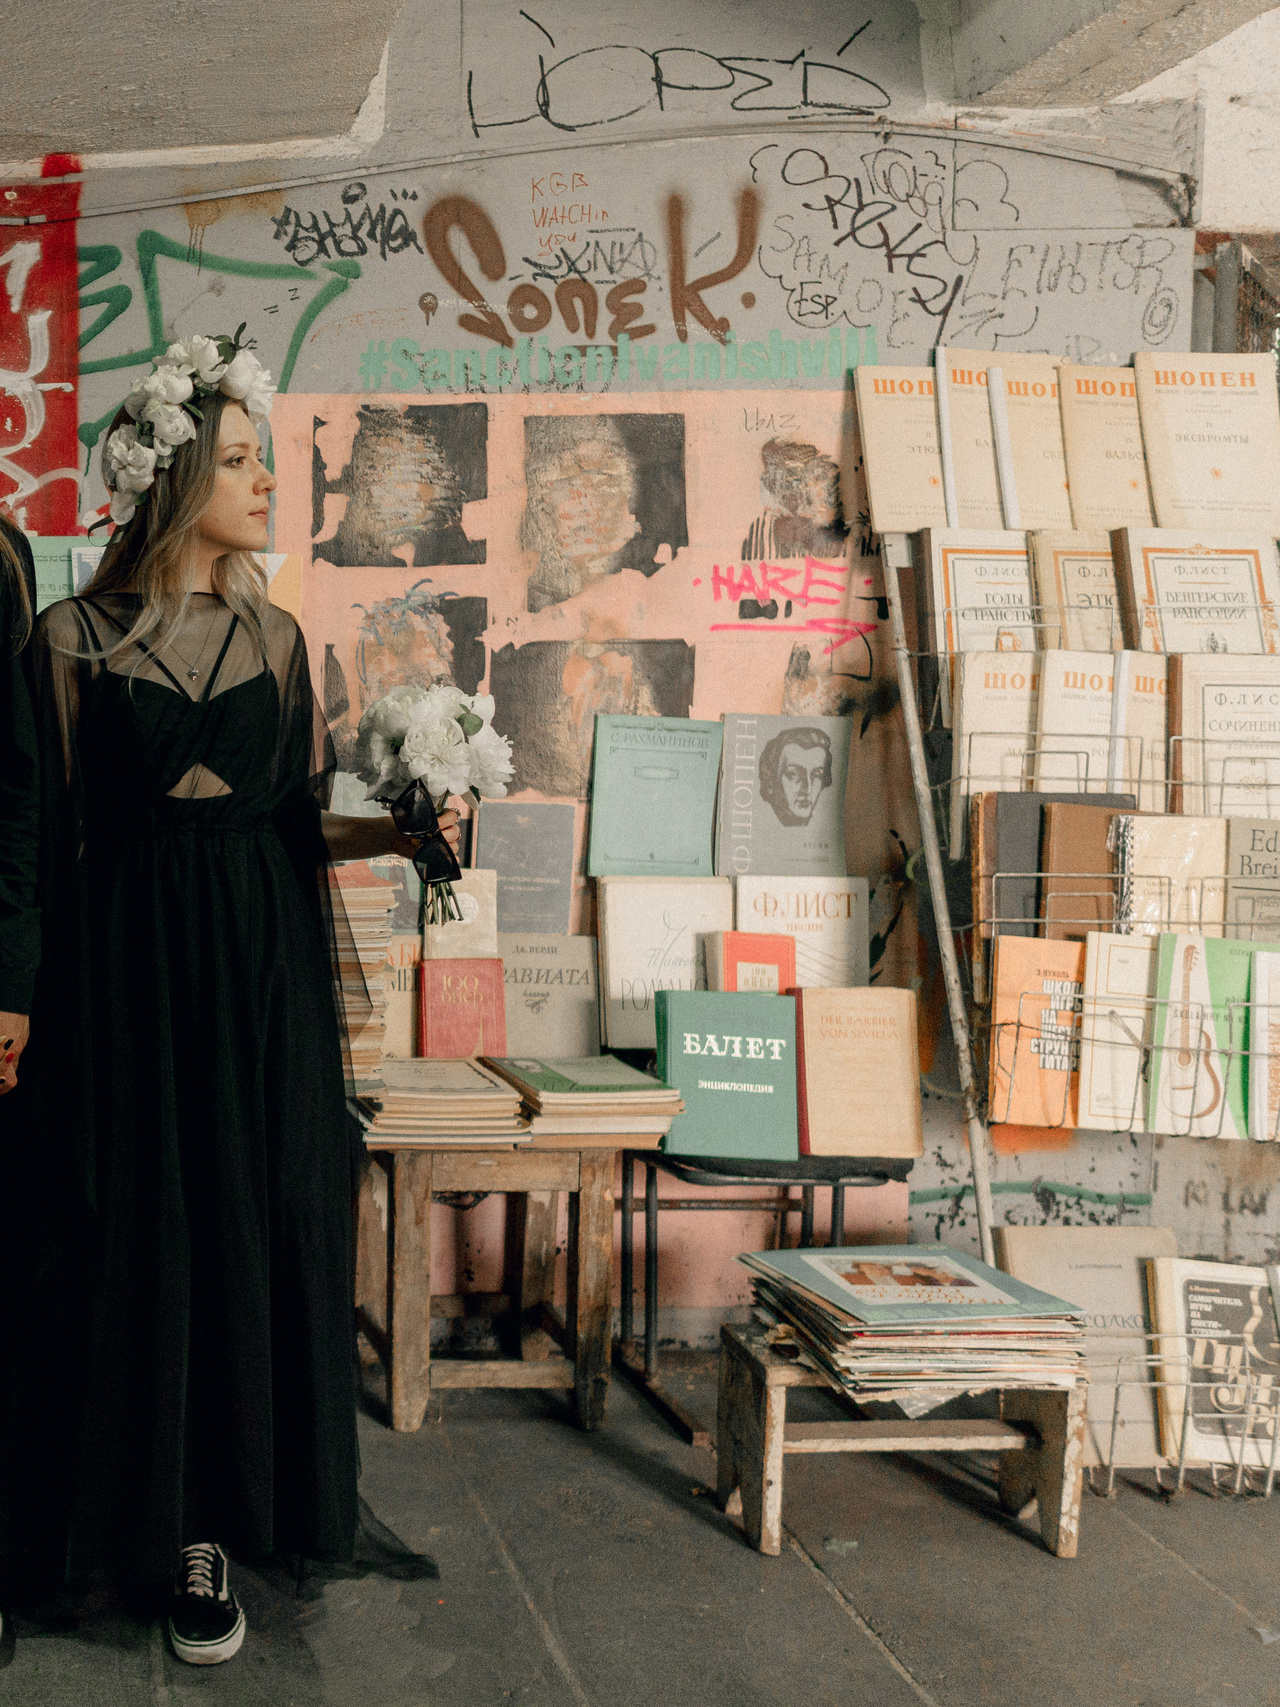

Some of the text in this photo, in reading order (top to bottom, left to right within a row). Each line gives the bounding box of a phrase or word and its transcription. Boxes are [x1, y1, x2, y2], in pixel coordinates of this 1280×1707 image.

[531, 172, 589, 203] KGB
[1155, 370, 1257, 388] ШОПЕН
[1175, 433, 1249, 444] ЭКСПРОМТЫ
[984, 592, 1024, 605] ГОДЫ
[1165, 590, 1249, 604] ВЕНГЕРСКИЕ
[1172, 607, 1248, 620] РАПСОДИИ
[529, 946, 558, 954] ВЕРДИ
[821, 1016, 896, 1026] DER BARBIER
[821, 1029, 899, 1039] VON SEVILLA
[683, 1033, 786, 1060] БАЛЕТ
[698, 1080, 773, 1093] ЭНЦИКЛОПЕДИЯ
